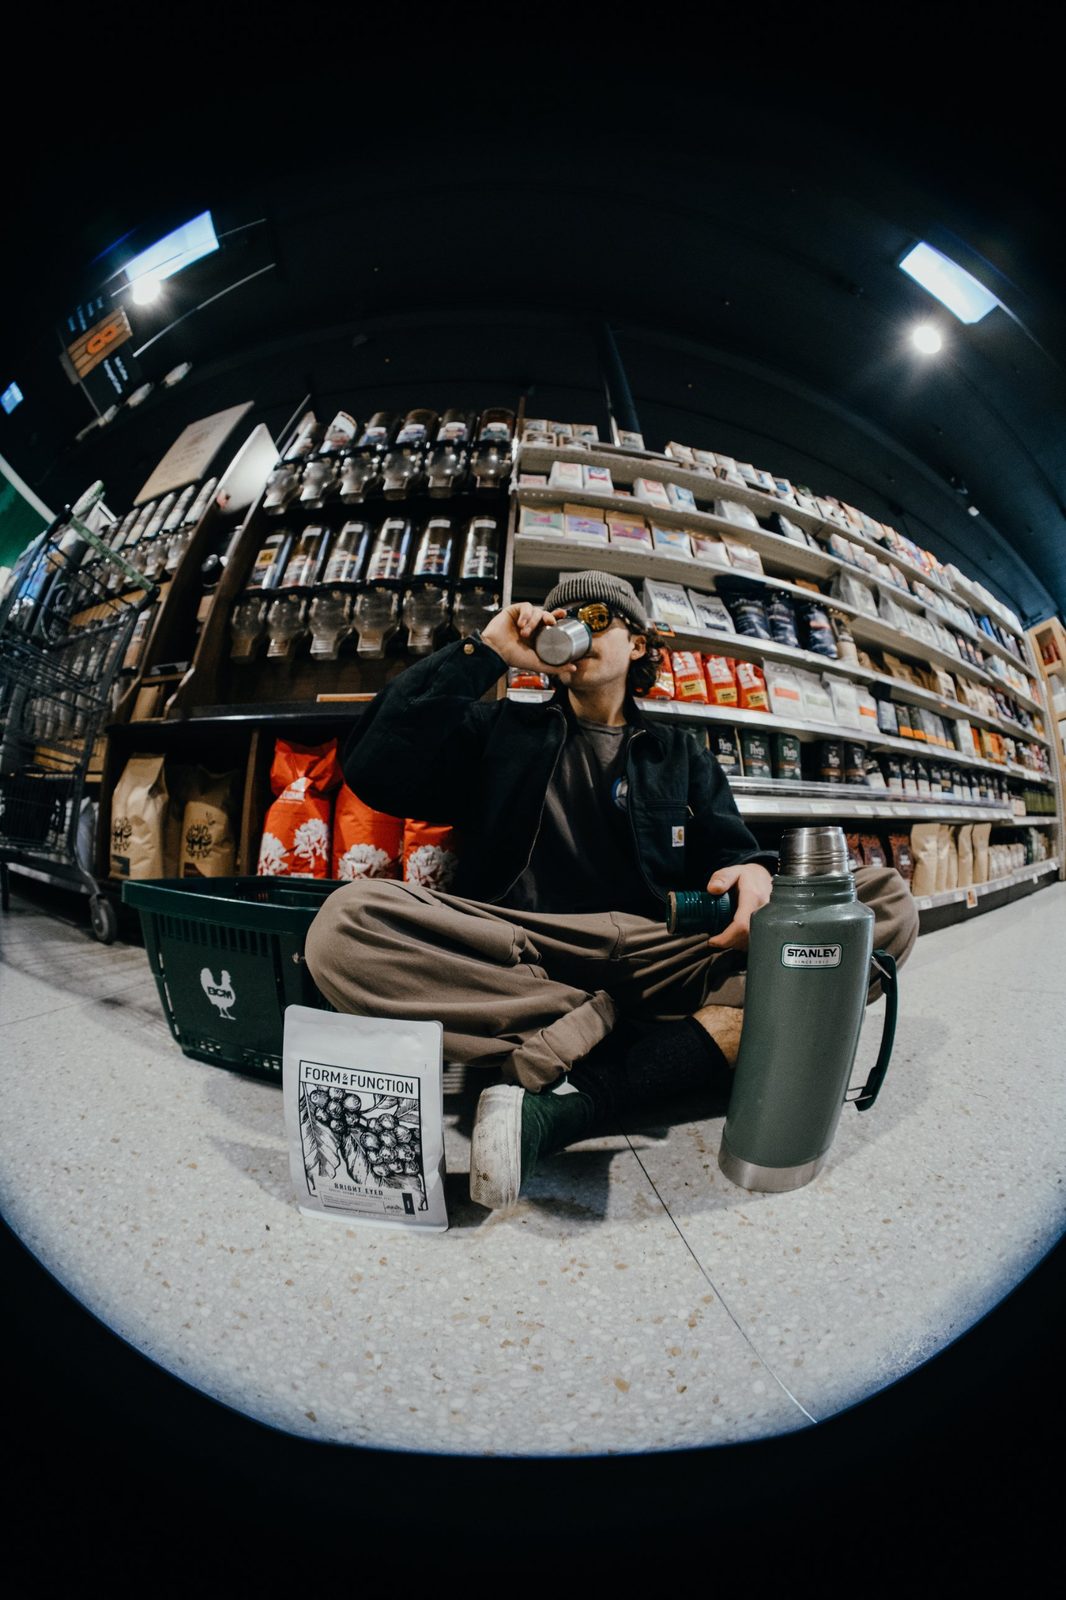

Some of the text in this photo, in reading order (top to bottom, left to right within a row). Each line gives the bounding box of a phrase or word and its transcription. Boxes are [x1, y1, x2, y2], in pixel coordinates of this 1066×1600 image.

[787, 948, 837, 958] STANLEY
[305, 1066, 341, 1084] FORM
[350, 1074, 414, 1095] FUNCTION
[334, 1182, 361, 1193] BRIGHT
